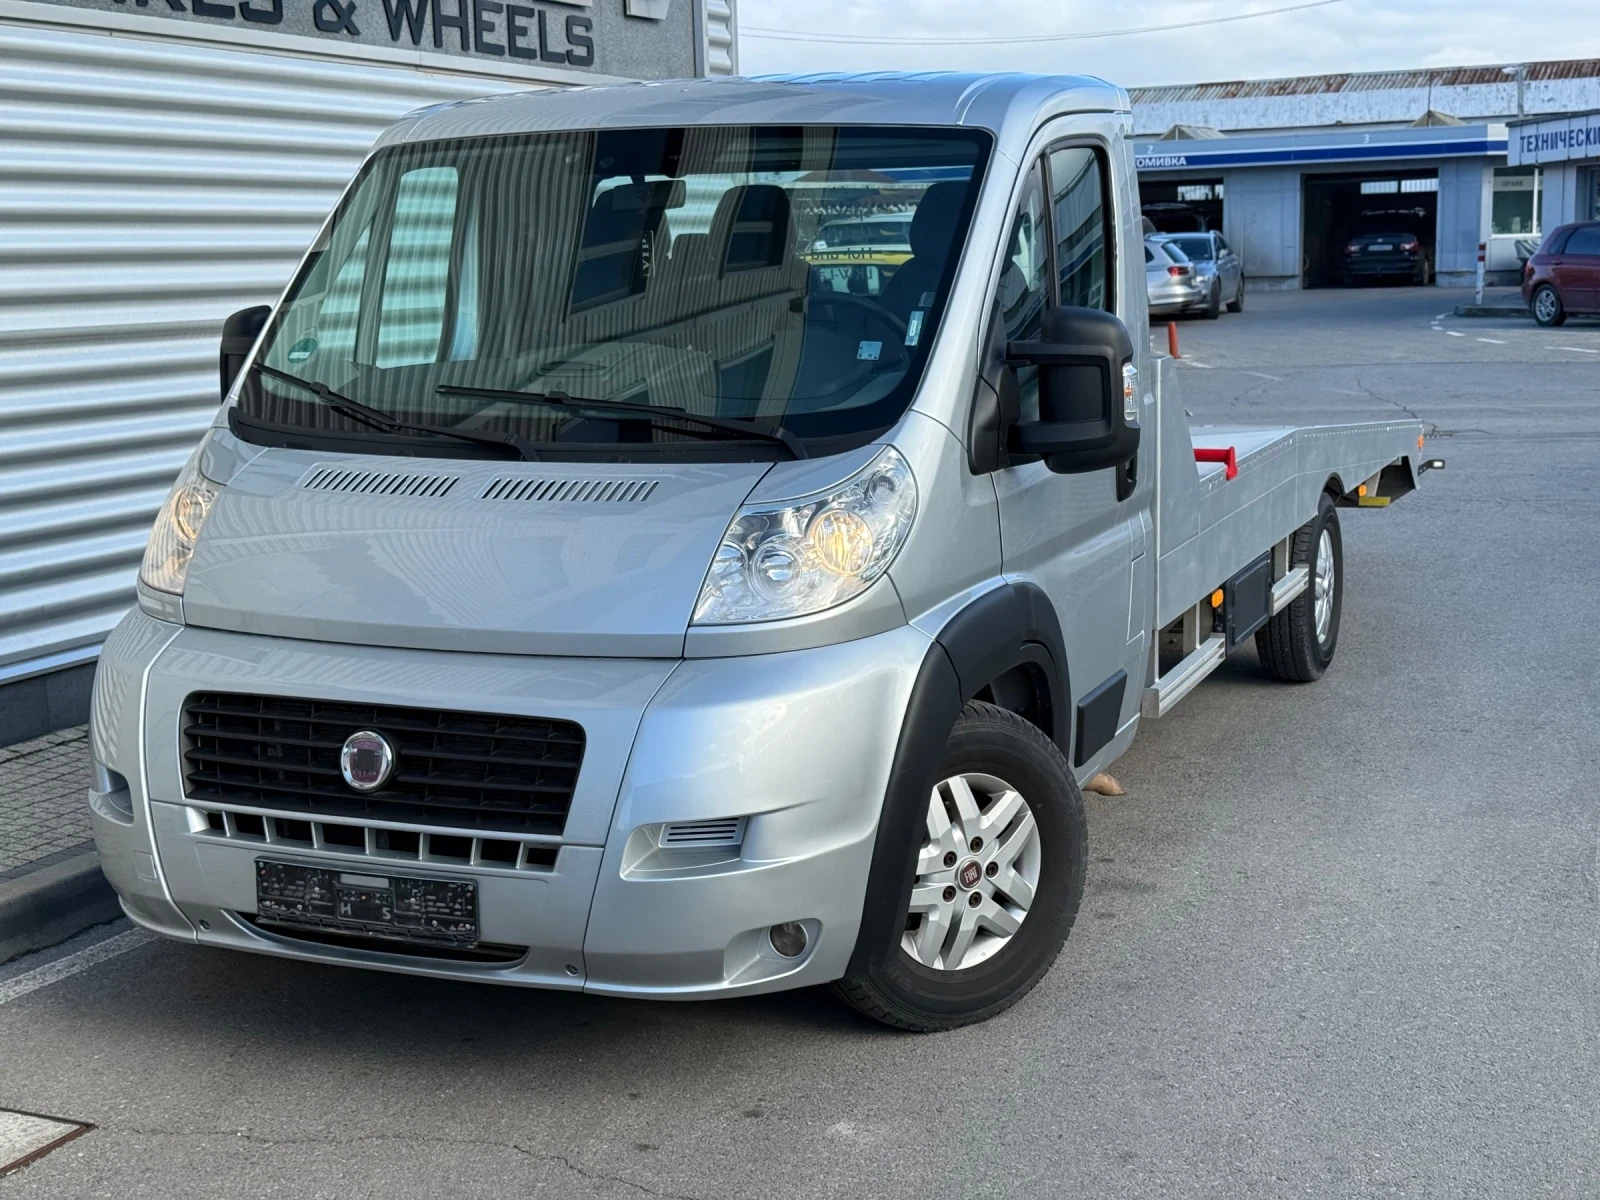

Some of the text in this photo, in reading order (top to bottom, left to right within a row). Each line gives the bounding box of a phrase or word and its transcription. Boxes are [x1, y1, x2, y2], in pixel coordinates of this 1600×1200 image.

[313, 0, 361, 36] &
[384, 0, 594, 66] WHEELS
[1363, 133, 1370, 144] 3
[1147, 145, 1153, 154] 2
[1135, 156, 1187, 168] ОМИВКА
[964, 866, 978, 884] FIAT
[382, 907, 391, 920] S
